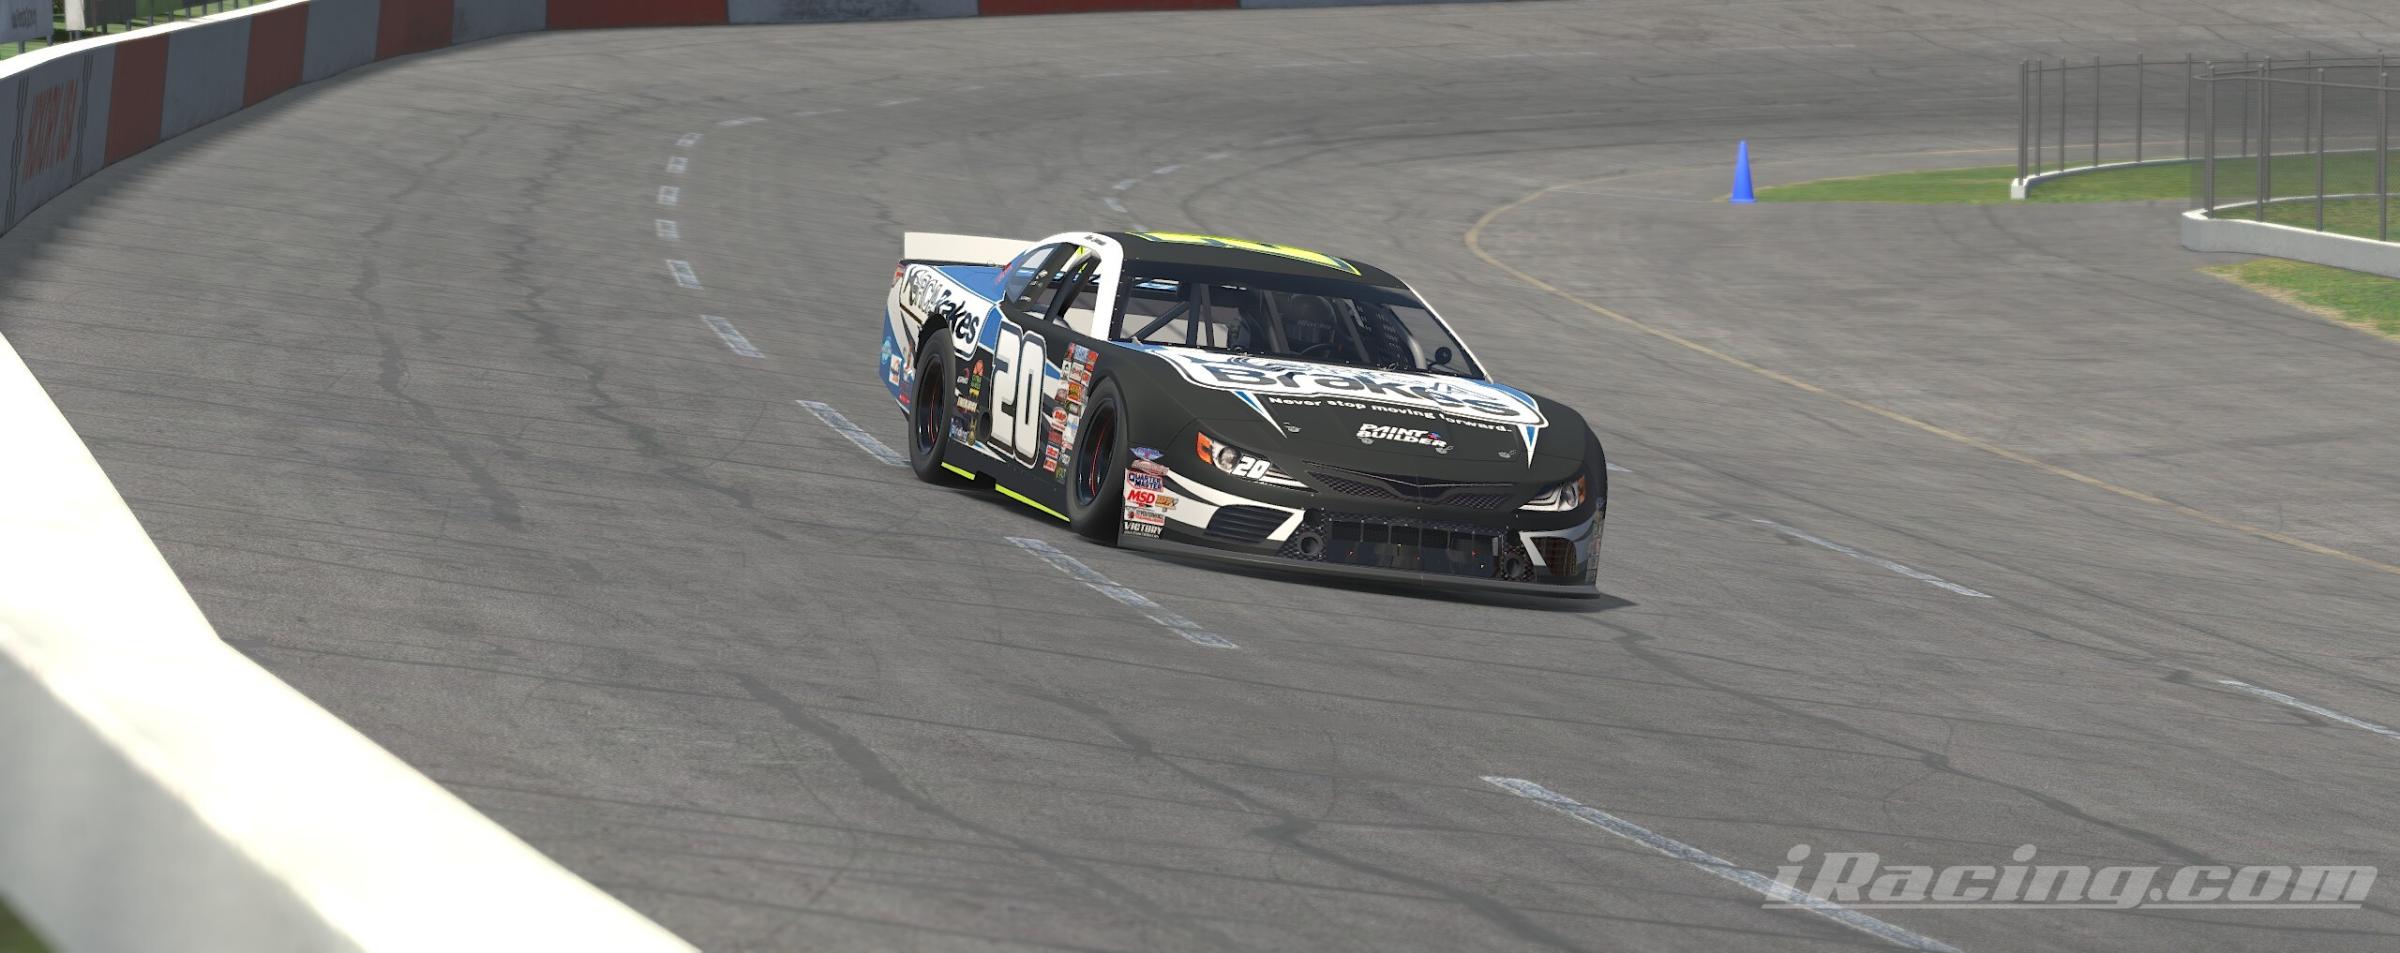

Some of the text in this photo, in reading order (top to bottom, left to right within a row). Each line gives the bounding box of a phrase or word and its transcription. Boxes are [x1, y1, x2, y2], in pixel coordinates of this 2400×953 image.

[988, 323, 1046, 464] 20
[1204, 365, 1520, 417] Brakes
[1269, 396, 1321, 407] Never
[1327, 400, 1367, 410] stop
[1371, 404, 1436, 420] moving
[1357, 430, 1447, 448] BUILDER
[1360, 423, 1428, 438] PAINT
[1231, 455, 1271, 480] 20
[1127, 489, 1156, 504] MSD
[1124, 521, 1163, 535] VICTORY
